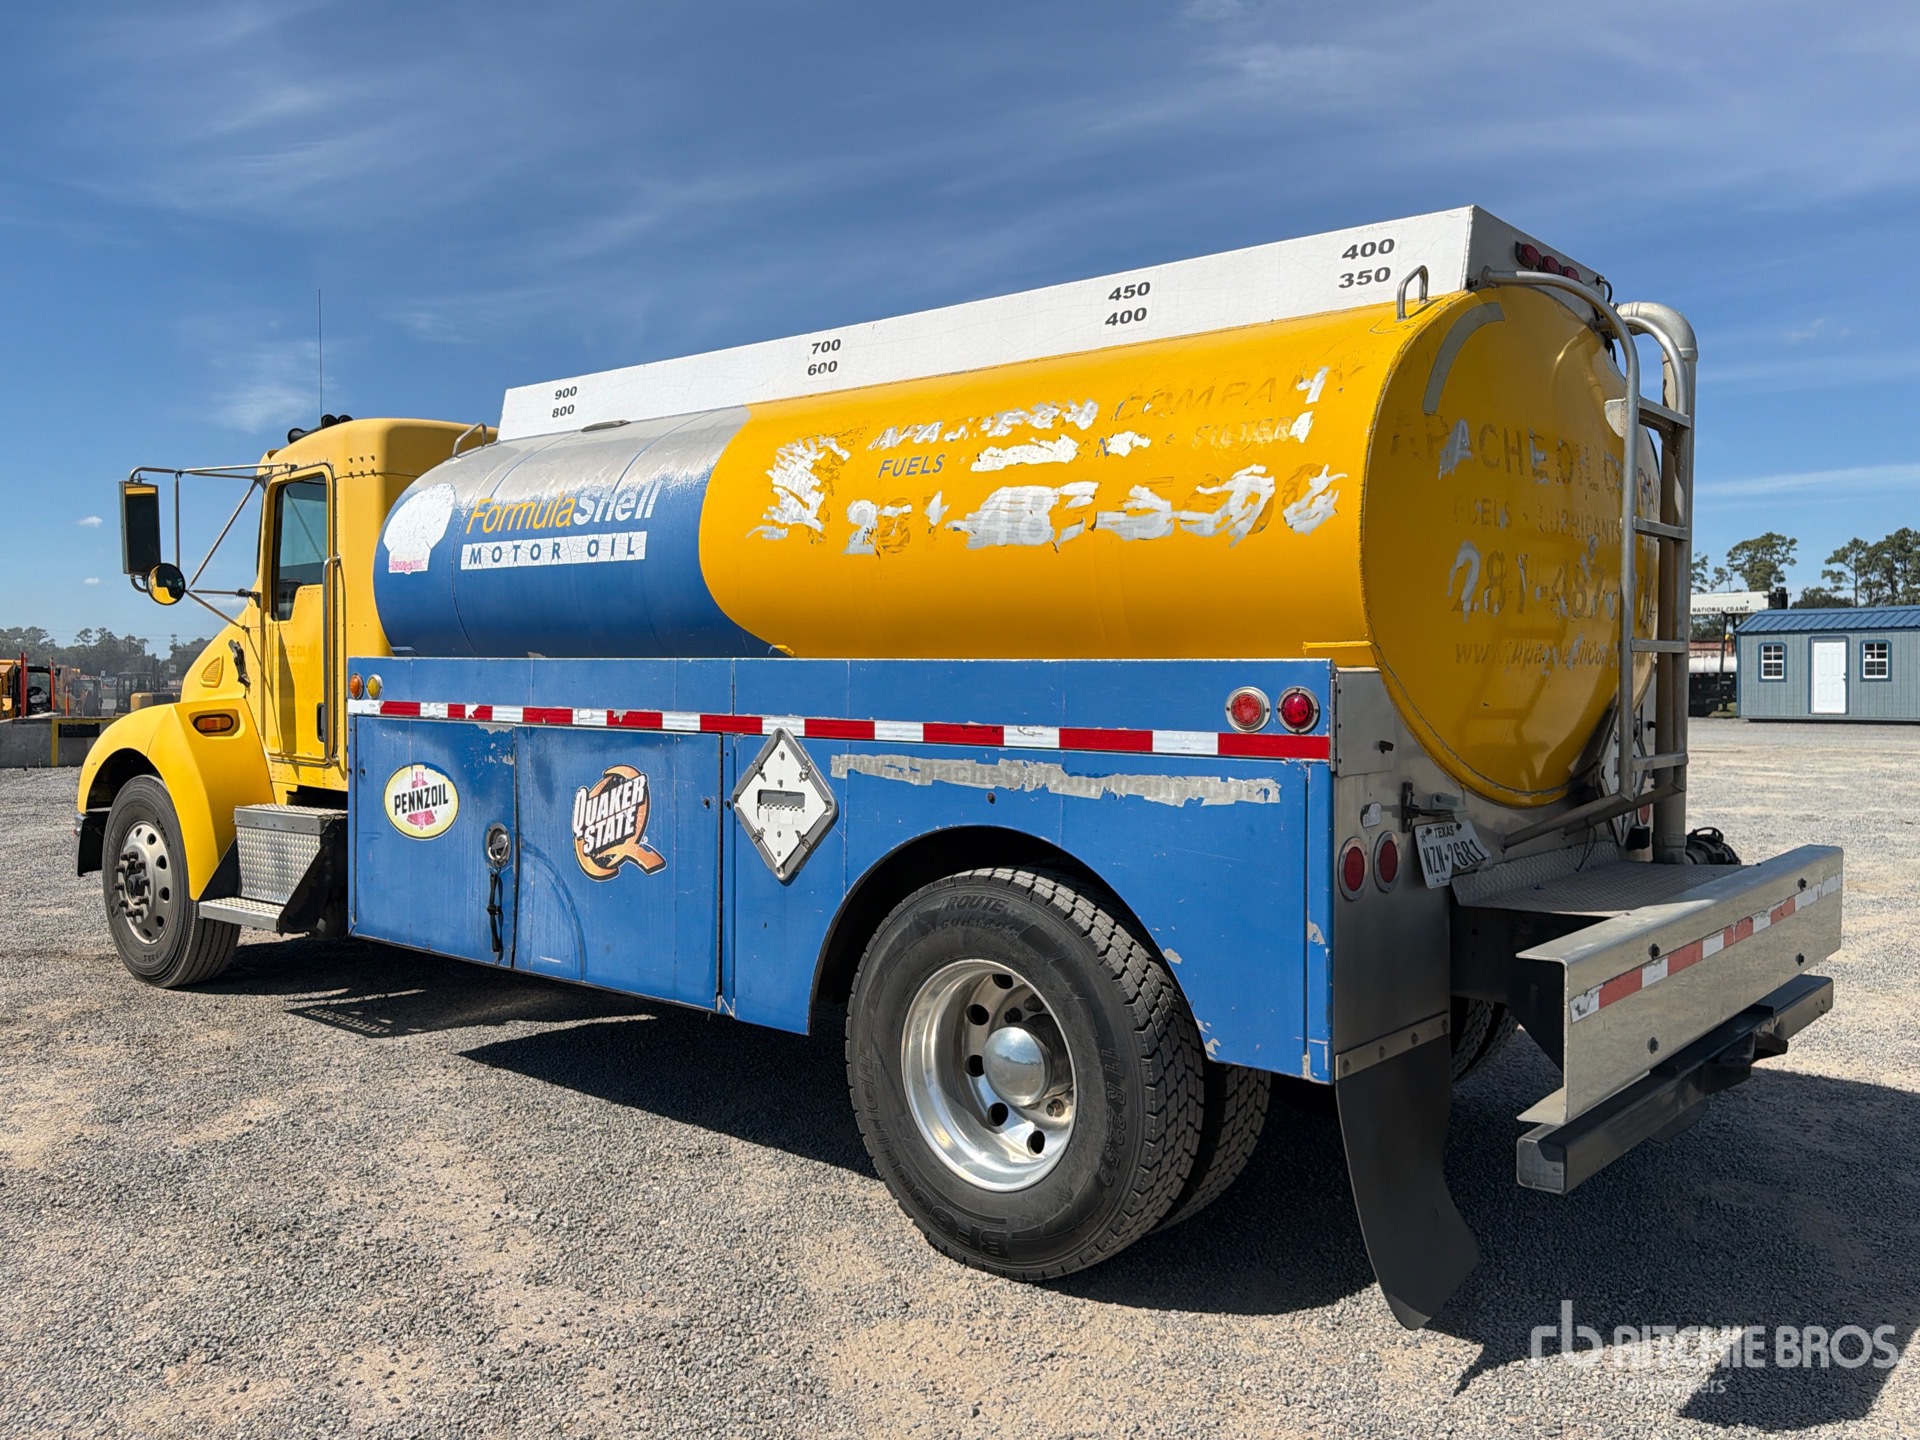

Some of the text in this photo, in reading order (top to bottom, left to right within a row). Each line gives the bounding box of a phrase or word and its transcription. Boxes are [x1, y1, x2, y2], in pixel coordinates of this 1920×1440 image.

[1341, 238, 1395, 260] 400
[1338, 266, 1391, 289] 350
[1108, 282, 1151, 301] 450
[1105, 307, 1148, 327] 400
[812, 339, 842, 355] 700
[807, 360, 838, 376] 600
[555, 386, 578, 400] 900
[552, 404, 575, 418] 800
[878, 453, 945, 479] FUELS
[469, 535, 635, 565] MOTOR OIL
[1725, 605, 1749, 613] CRANE
[394, 783, 449, 816] PENNZOIL
[573, 774, 646, 838] QUAKER
[583, 806, 637, 854] STATE
[1434, 825, 1455, 839] TEXAS
[940, 894, 1009, 914] ROUTE
